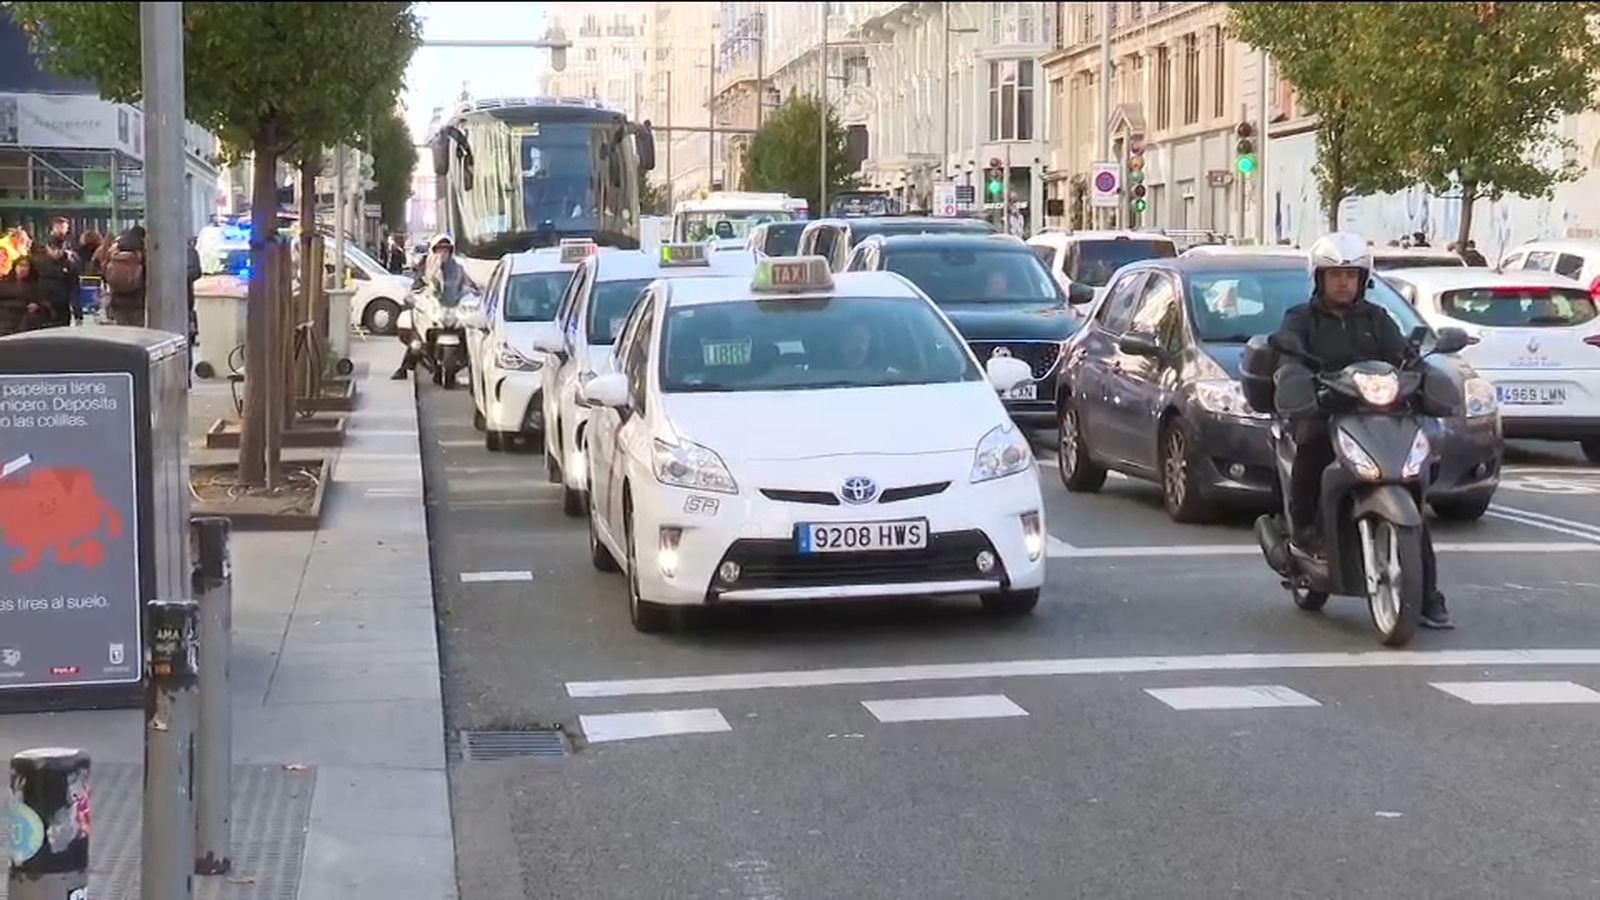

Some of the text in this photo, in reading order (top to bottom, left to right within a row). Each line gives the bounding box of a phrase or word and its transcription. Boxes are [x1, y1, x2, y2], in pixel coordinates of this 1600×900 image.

[773, 265, 806, 283] TAXI
[705, 344, 750, 364] LIBRE
[3, 381, 106, 397] papelera tiene
[1504, 388, 1538, 401] 4969
[53, 397, 117, 412] Deposita
[13, 414, 34, 428] las
[37, 413, 88, 428] colillas.
[686, 496, 718, 514] SP
[814, 524, 922, 548] 9208 HWS
[17, 597, 49, 611] tires
[51, 596, 64, 609] al
[66, 594, 110, 609] suelo.
